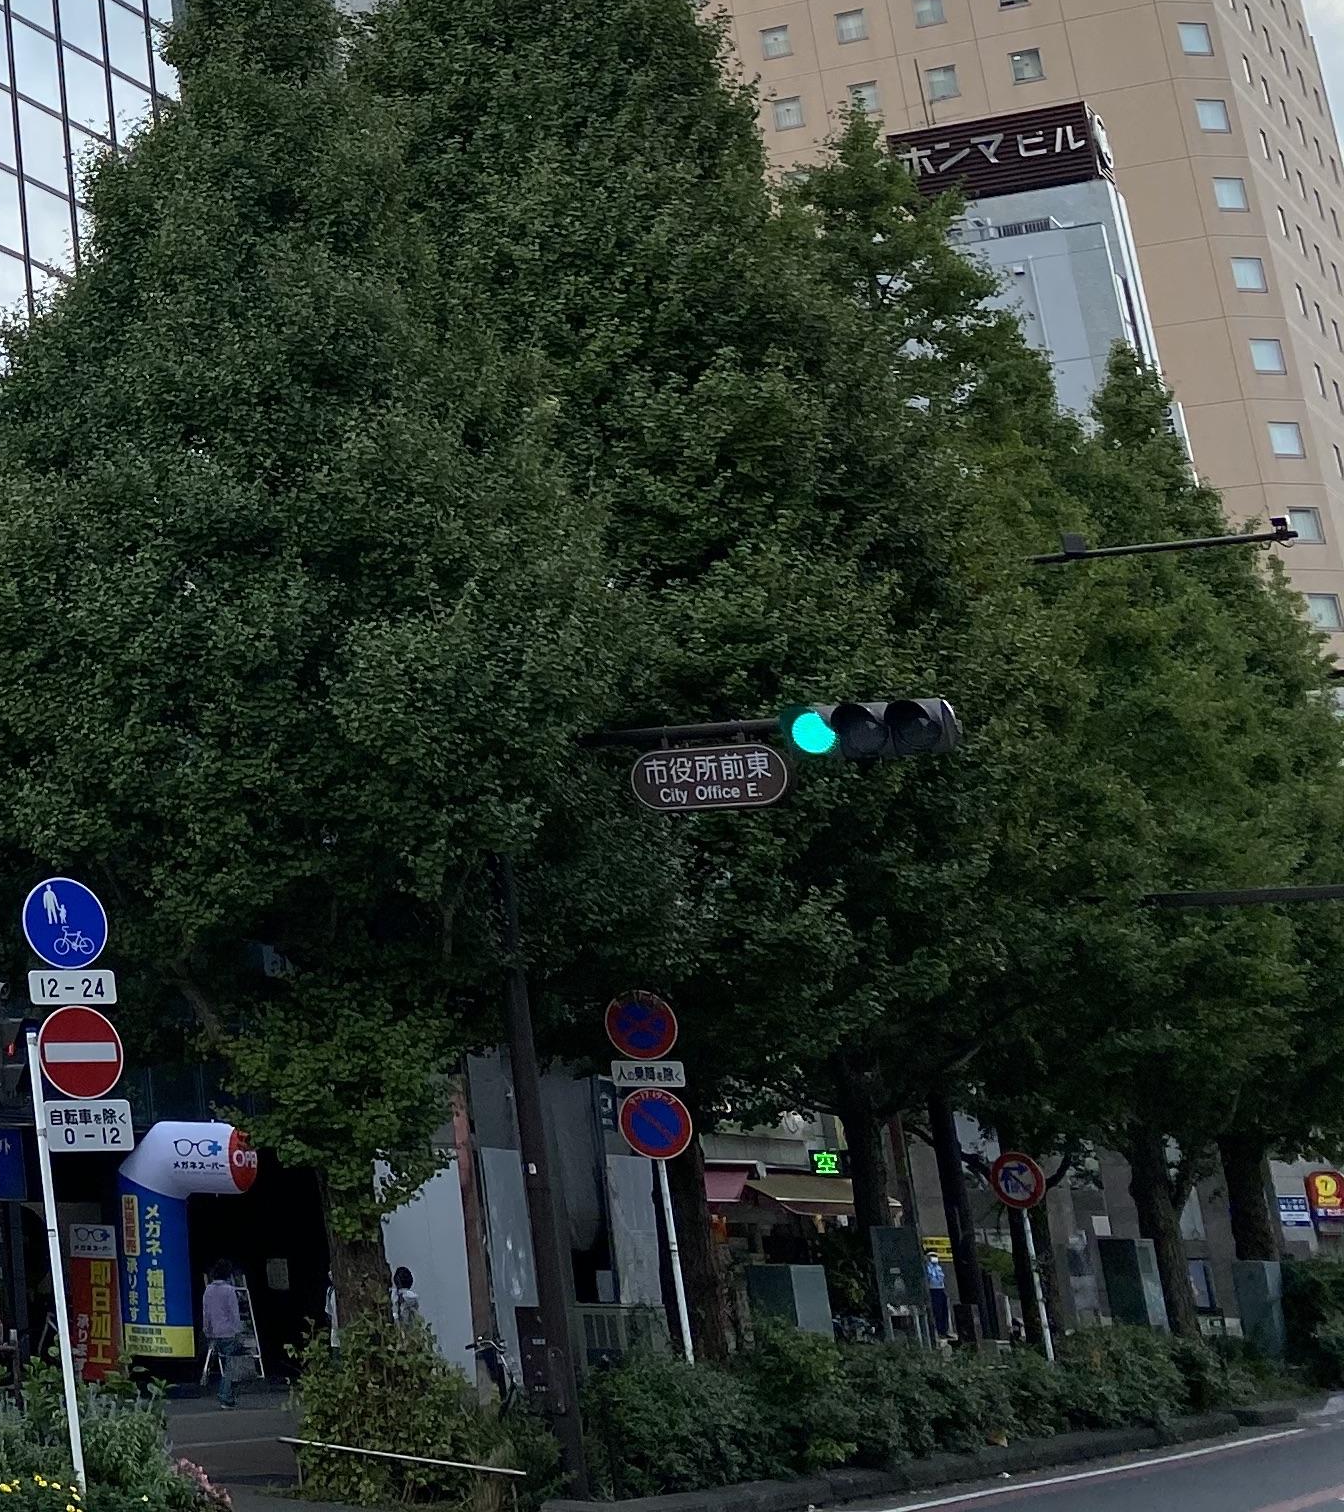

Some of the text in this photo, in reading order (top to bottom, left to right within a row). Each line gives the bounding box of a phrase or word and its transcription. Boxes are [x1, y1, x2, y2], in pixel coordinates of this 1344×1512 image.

[895, 124, 1087, 176] ホンマビル
[643, 752, 772, 786] 市役所前東
[659, 782, 763, 805] City Office E.
[50, 1108, 127, 1126] 自転車を除く
[172, 1160, 226, 1170] メガネスーパー
[814, 1151, 840, 1174] 空
[89, 1260, 112, 1365] 即日加工
